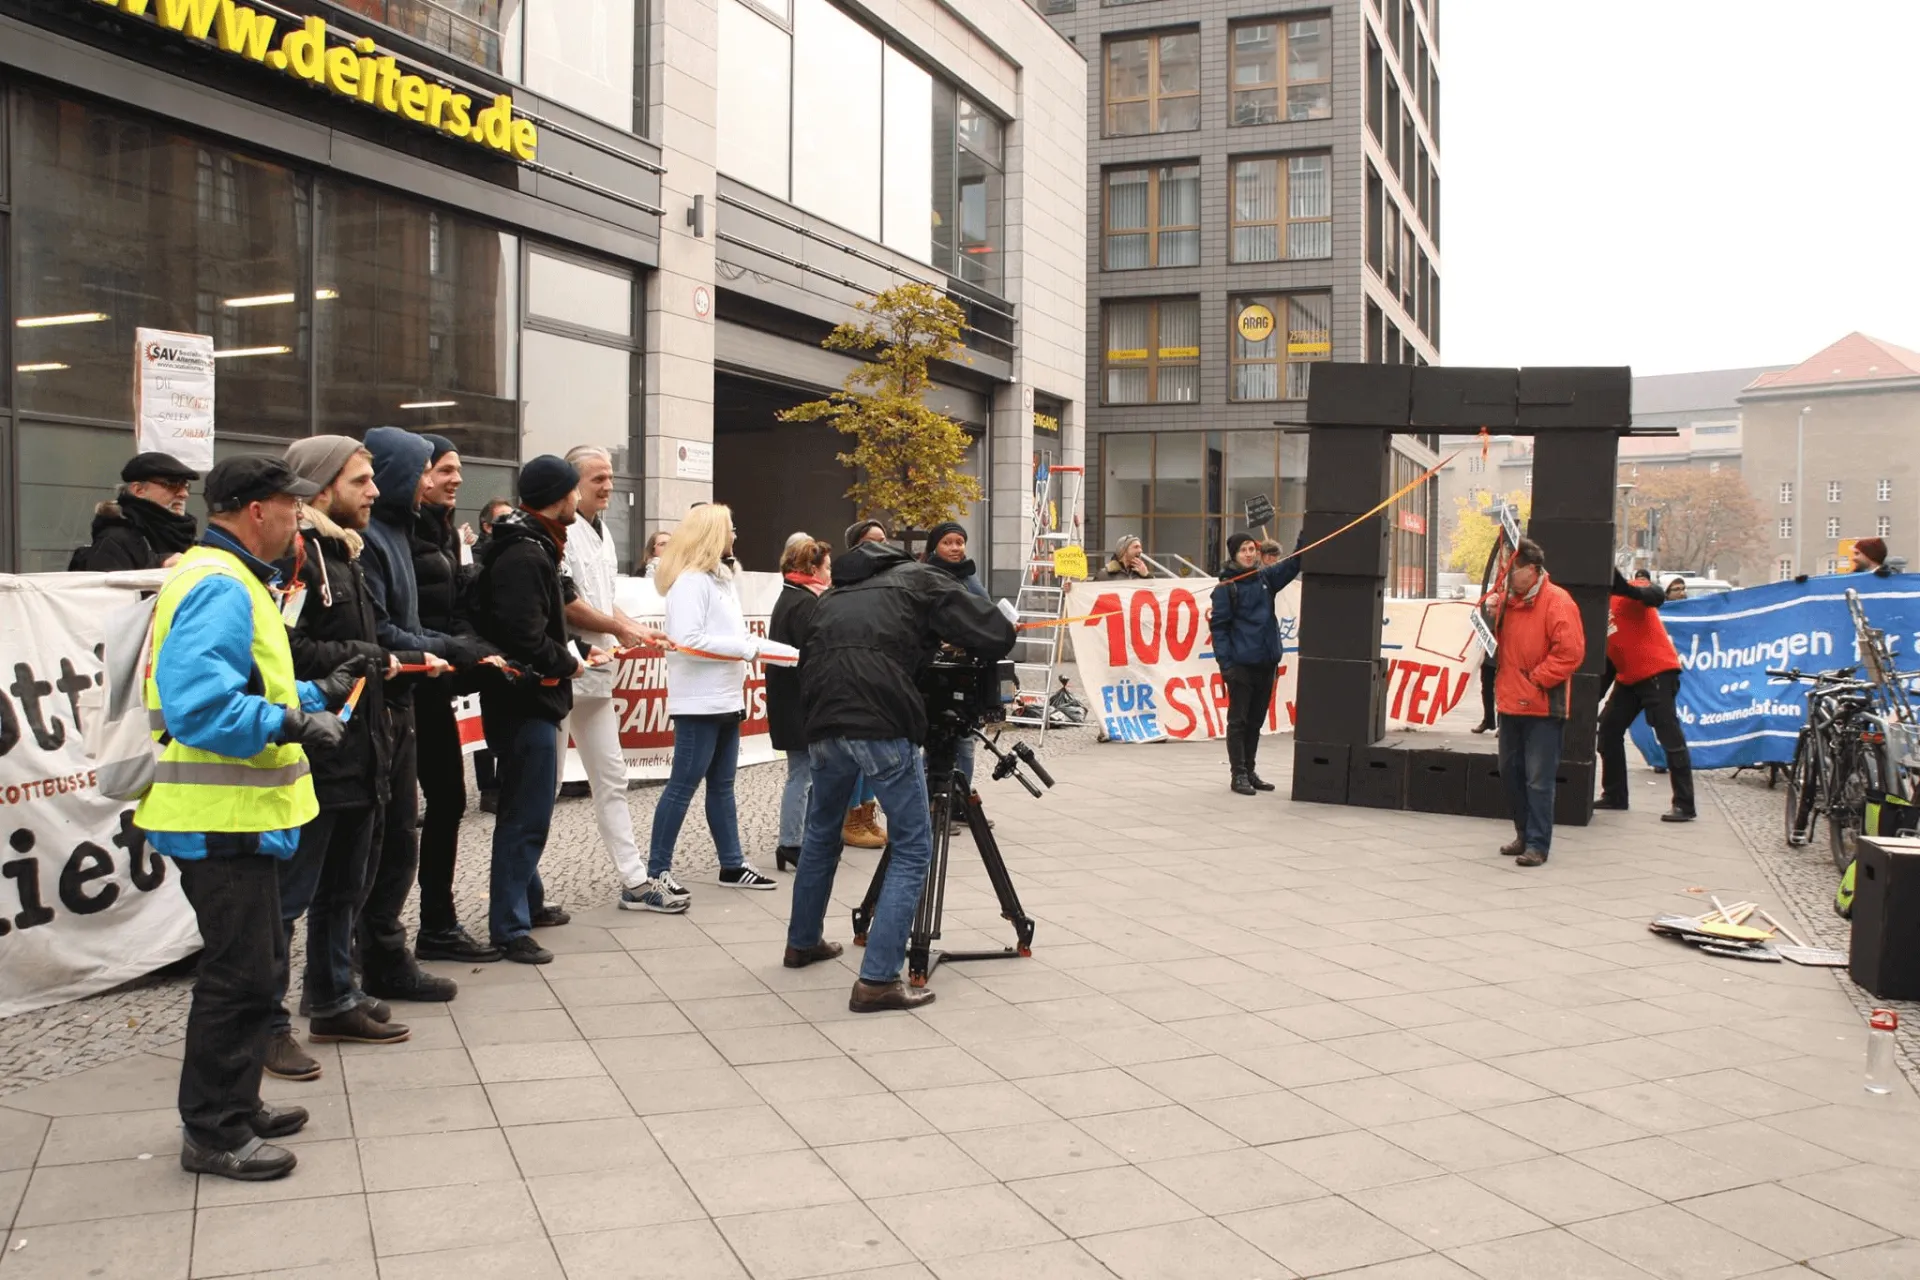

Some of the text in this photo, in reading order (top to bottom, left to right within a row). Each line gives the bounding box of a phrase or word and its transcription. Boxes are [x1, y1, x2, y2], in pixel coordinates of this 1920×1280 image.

[1243, 316, 1269, 329] ARAG
[152, 346, 178, 361] SAV
[155, 375, 173, 390] DIE
[1084, 588, 1212, 667] 100
[1669, 631, 1832, 672] Wohnungen
[1102, 680, 1157, 713] FÜR
[1105, 713, 1161, 741] EINE
